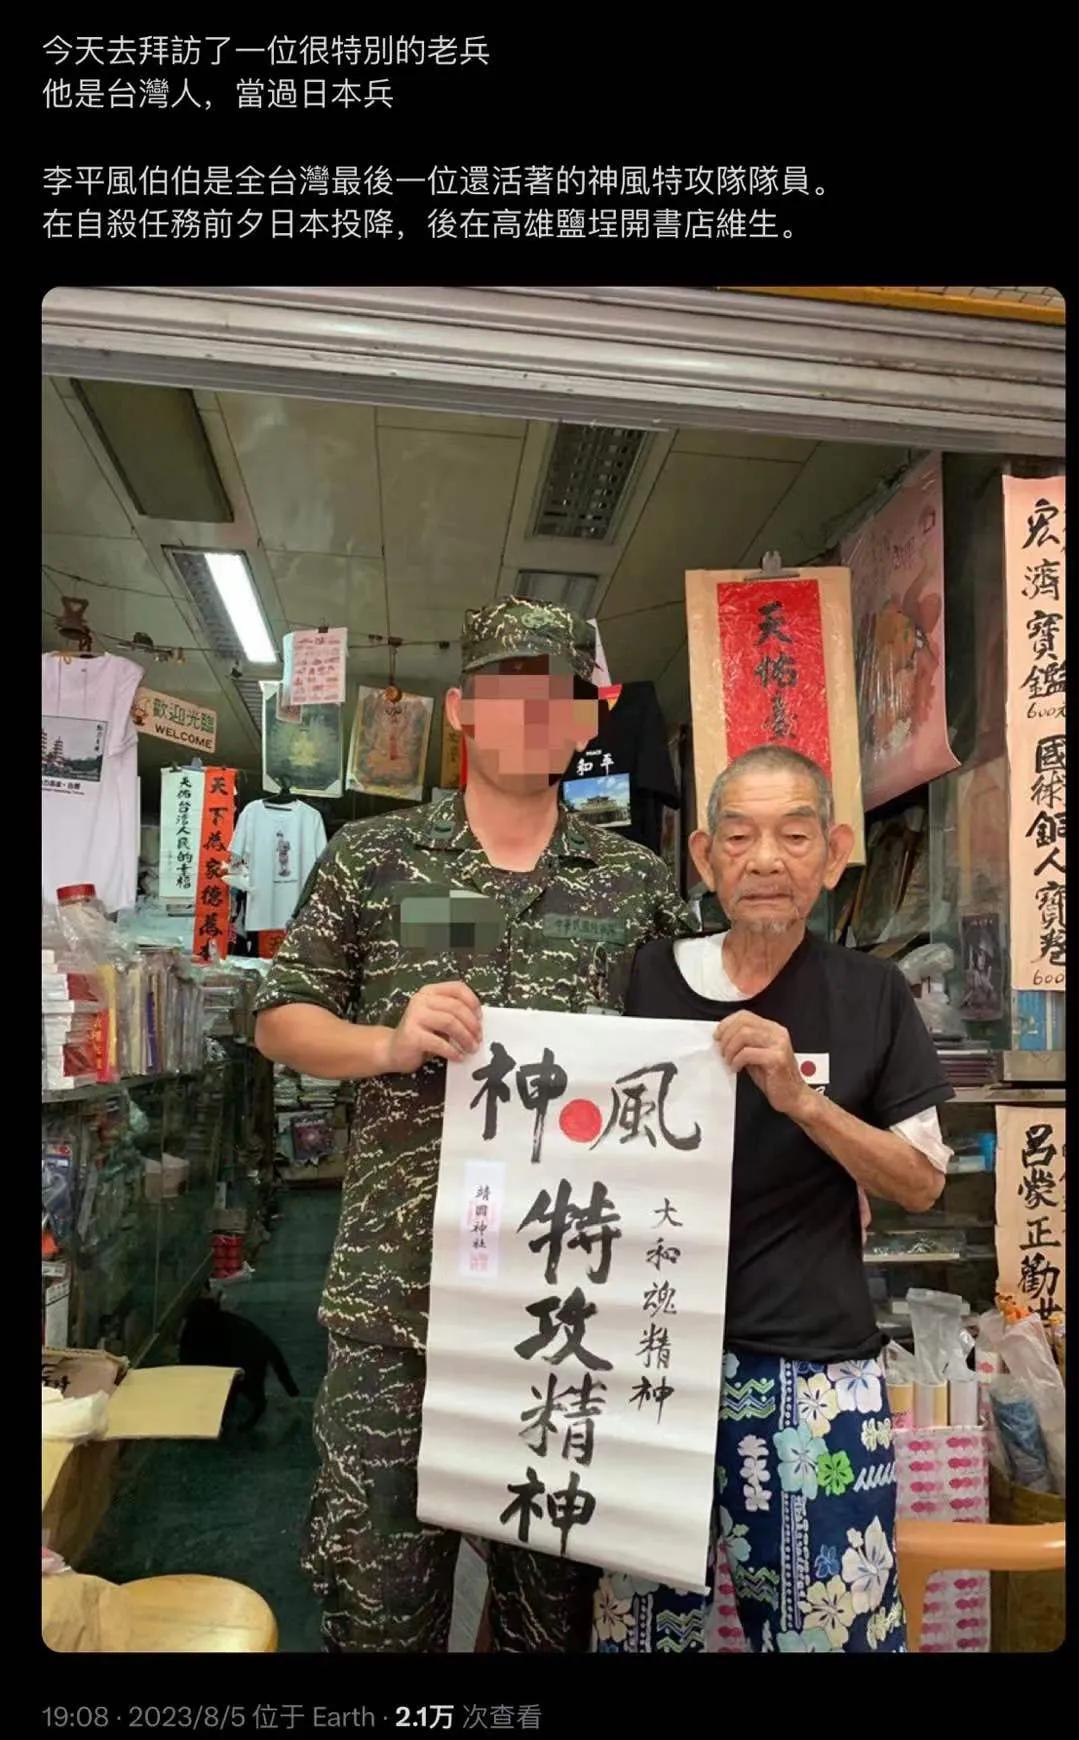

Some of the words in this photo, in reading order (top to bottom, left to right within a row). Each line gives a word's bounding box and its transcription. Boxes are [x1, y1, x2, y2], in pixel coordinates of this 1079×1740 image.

[154, 723, 213, 749] WELCOME
[575, 752, 615, 777] 和平
[627, 1197, 684, 1425] 大和魂精神
